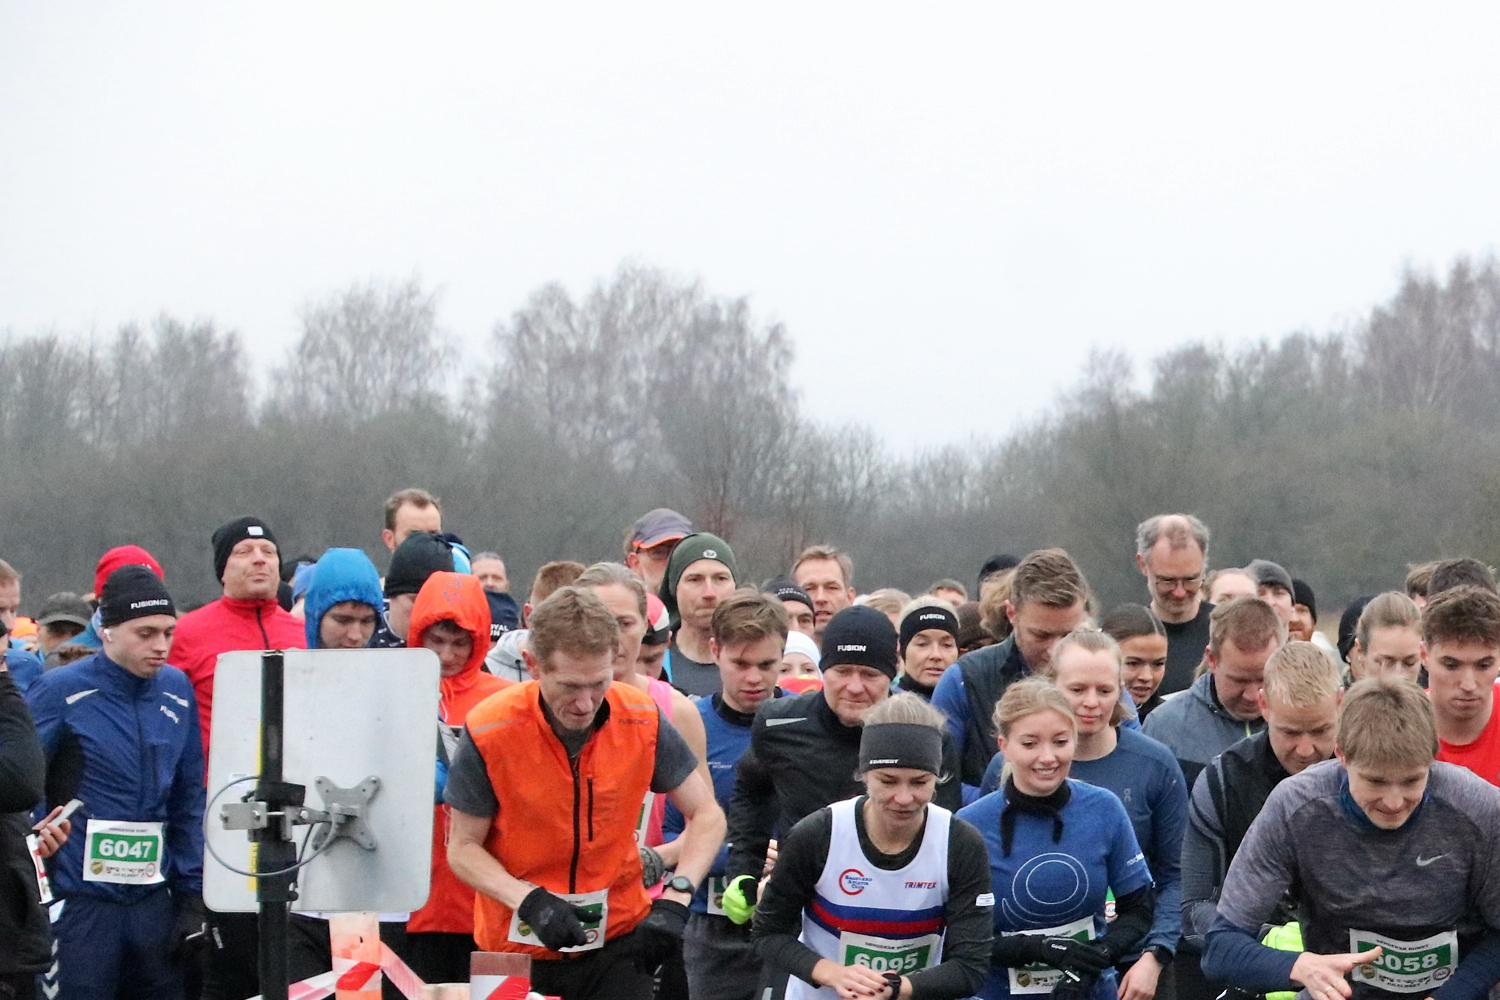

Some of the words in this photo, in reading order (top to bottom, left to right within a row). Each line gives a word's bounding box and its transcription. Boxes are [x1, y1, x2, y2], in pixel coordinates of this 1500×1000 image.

[919, 613, 946, 621] FUSION
[490, 623, 509, 631] YAL
[837, 644, 867, 652] FUSION
[98, 838, 153, 859] 6047
[904, 881, 938, 890] TRIMTEX
[854, 951, 919, 974] 6095
